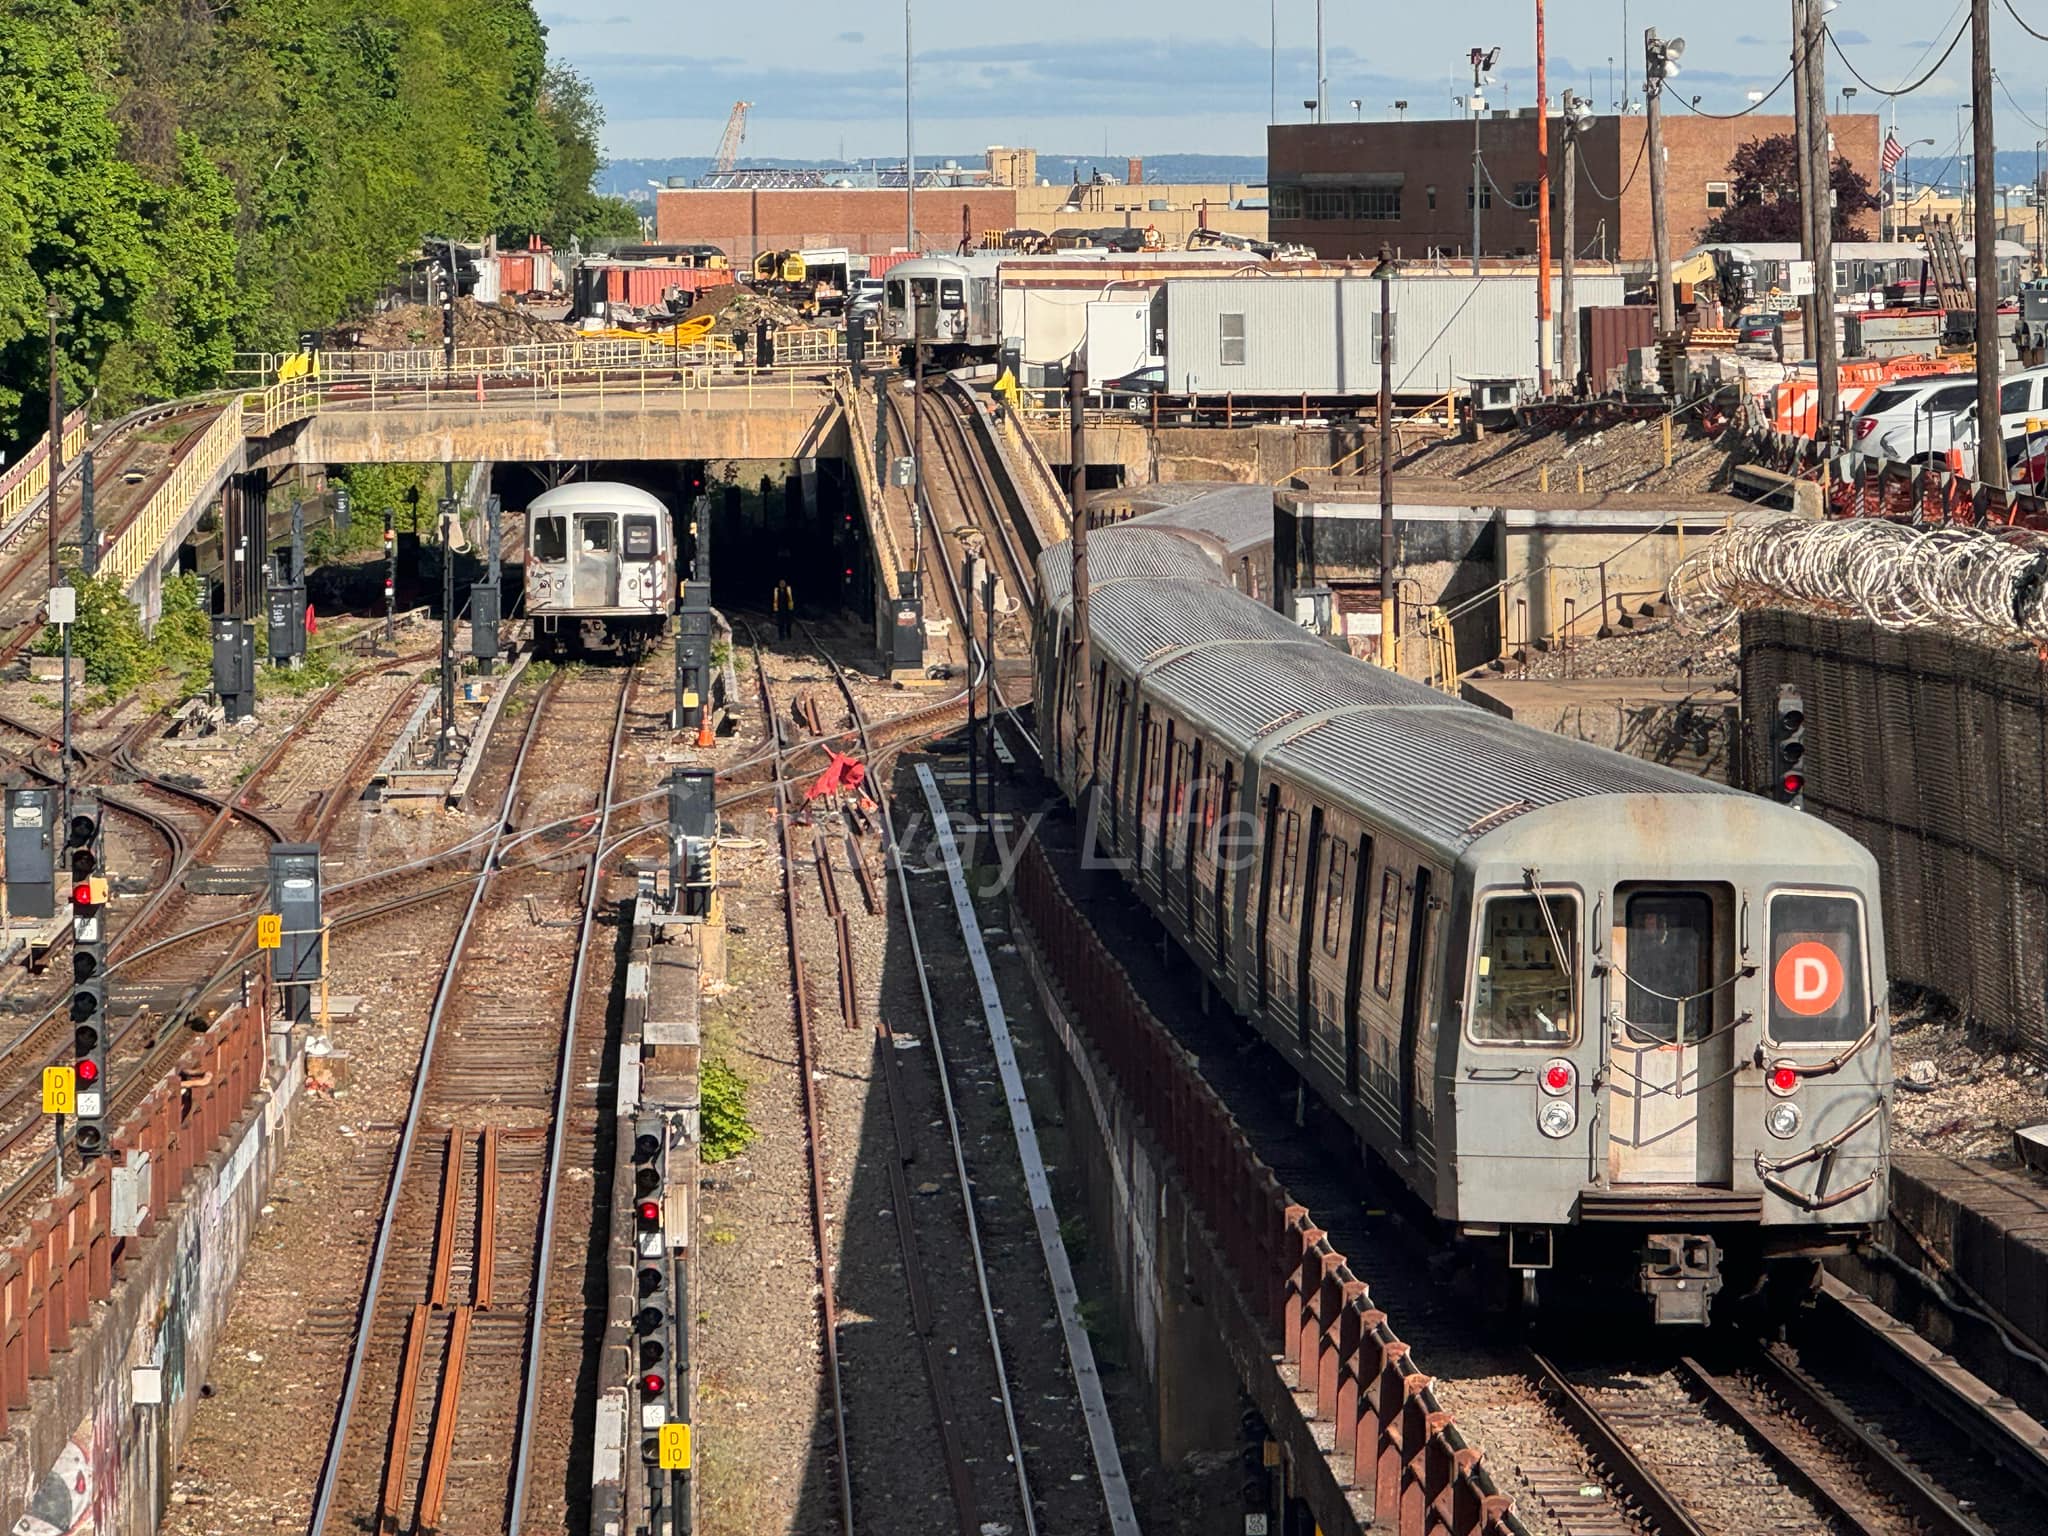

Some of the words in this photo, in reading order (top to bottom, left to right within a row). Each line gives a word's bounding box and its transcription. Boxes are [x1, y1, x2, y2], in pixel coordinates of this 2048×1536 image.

[263, 920, 276, 934] 10
[1794, 957, 1829, 1001] D
[54, 1074, 64, 1089] D
[51, 1091, 66, 1106] 10
[670, 1431, 679, 1446] D
[668, 1448, 682, 1462] 10
